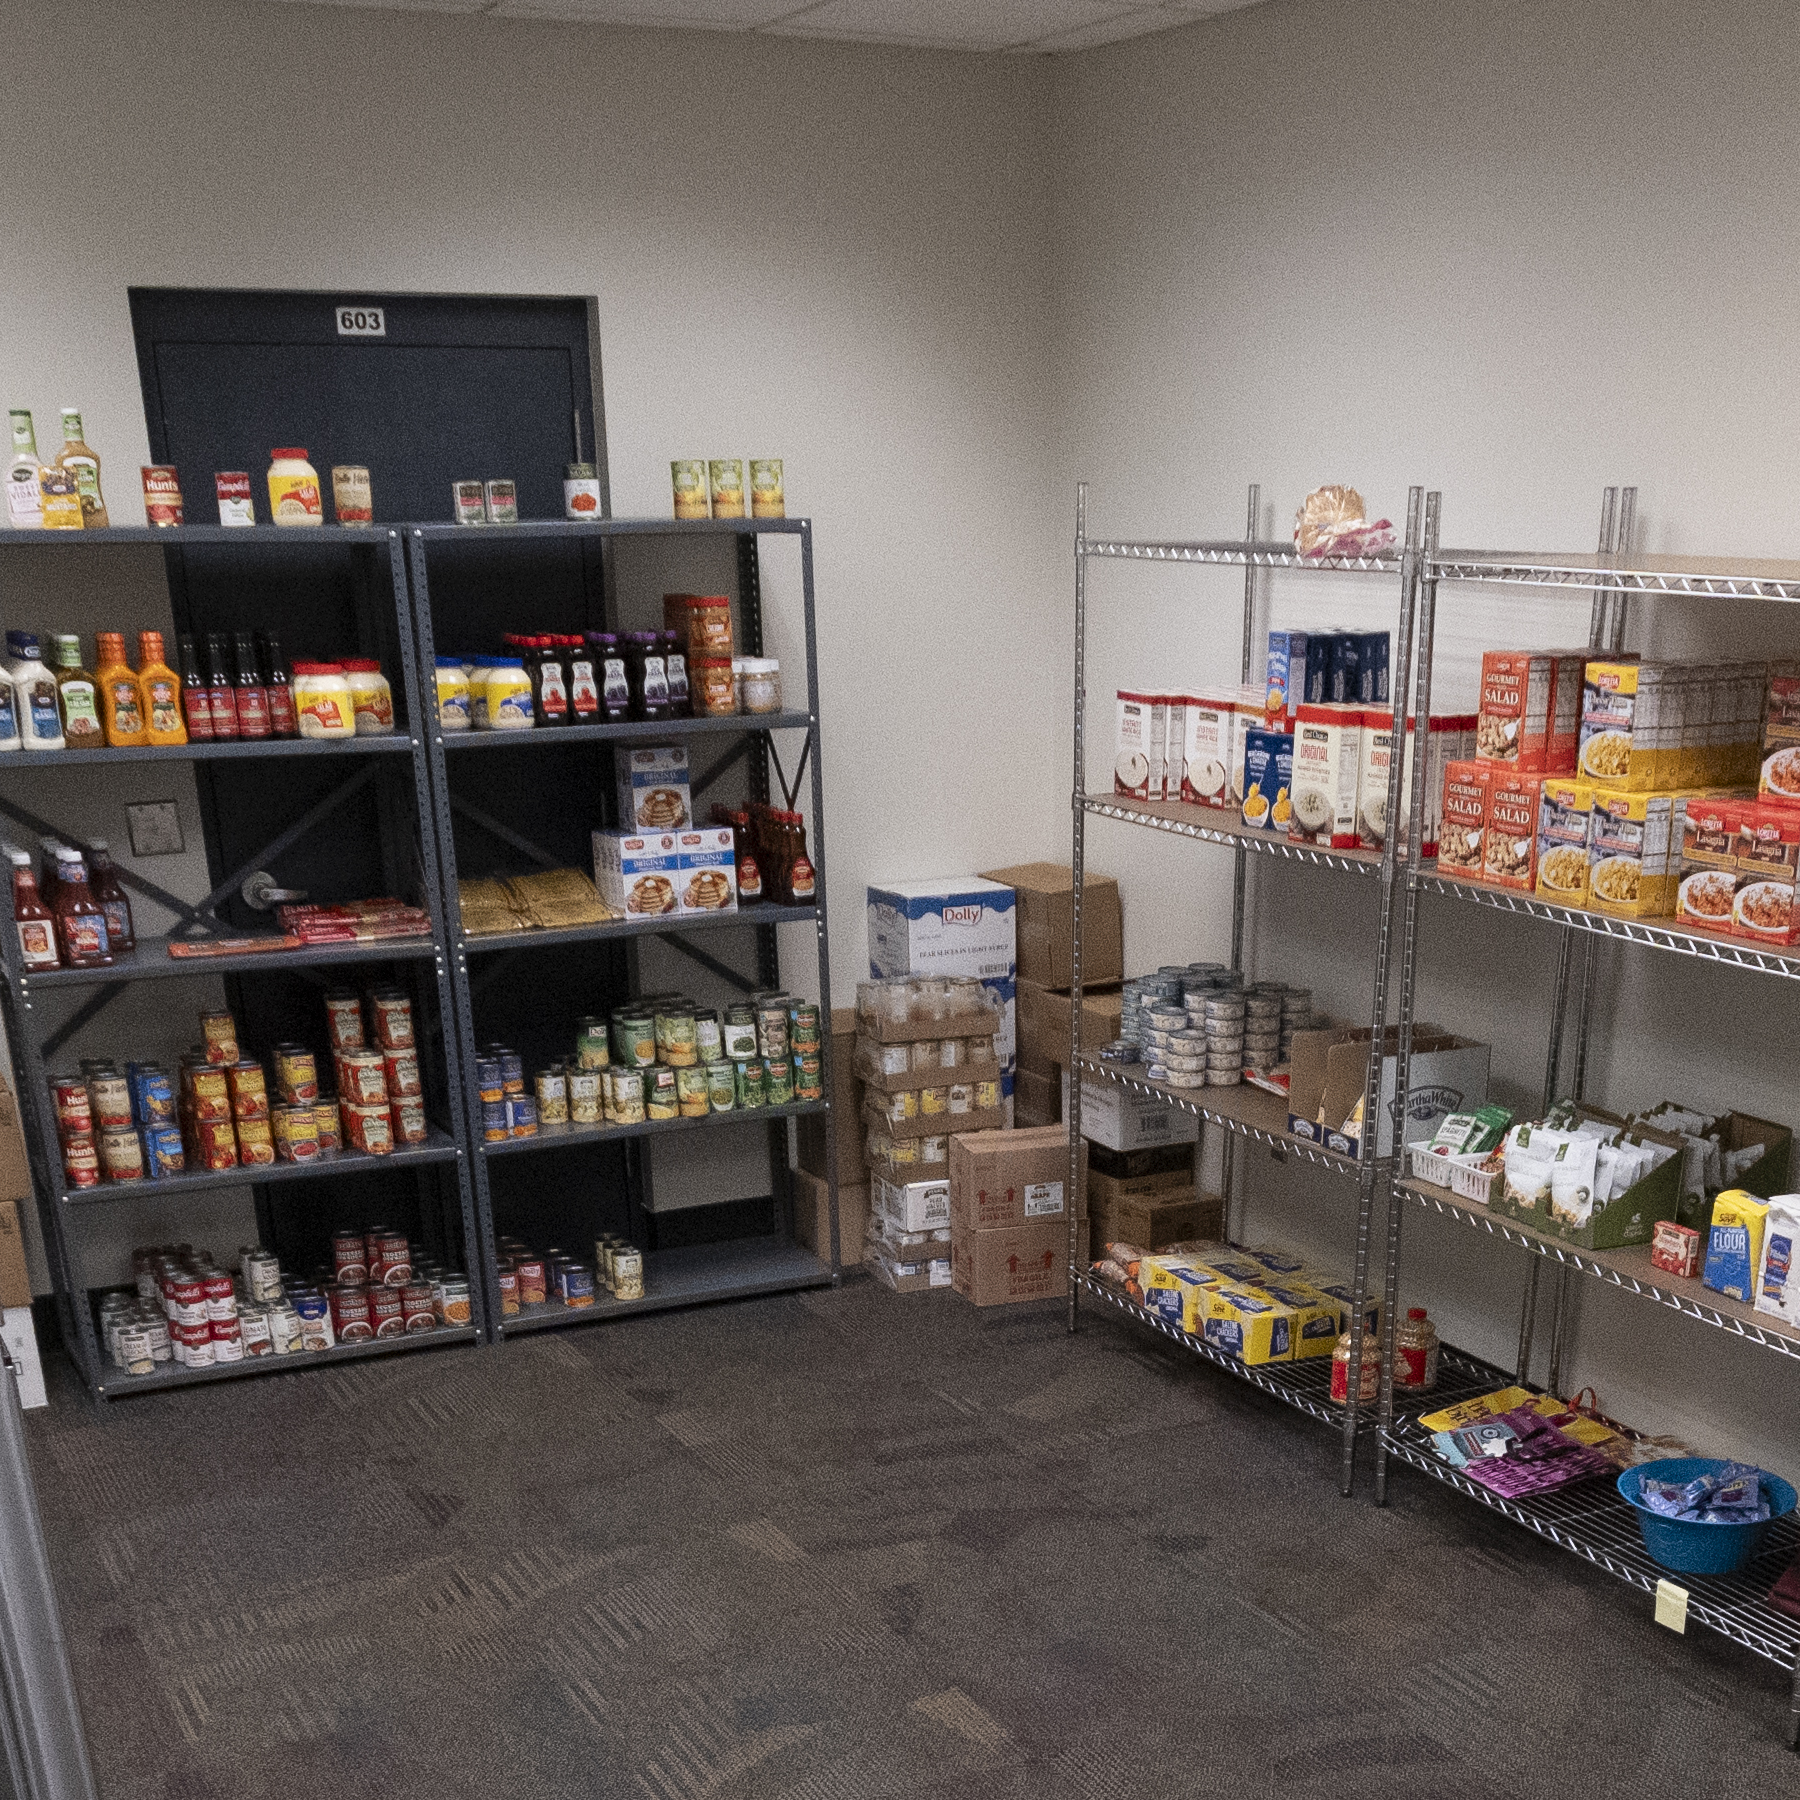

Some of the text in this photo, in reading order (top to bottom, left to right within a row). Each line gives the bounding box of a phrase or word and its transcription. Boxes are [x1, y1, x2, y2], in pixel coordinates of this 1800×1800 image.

[340, 311, 382, 331] 603
[1486, 673, 1520, 685] GOURMET
[1485, 689, 1519, 705] SALAD
[1449, 783, 1483, 797] GOURMET
[1495, 791, 1531, 805] GOURMET
[1447, 799, 1482, 816] SALAD
[1493, 806, 1530, 824] SALAD
[1752, 840, 1782, 857] Lasagna
[944, 907, 980, 924] Dolly
[1713, 1231, 1746, 1250] FLOUR
